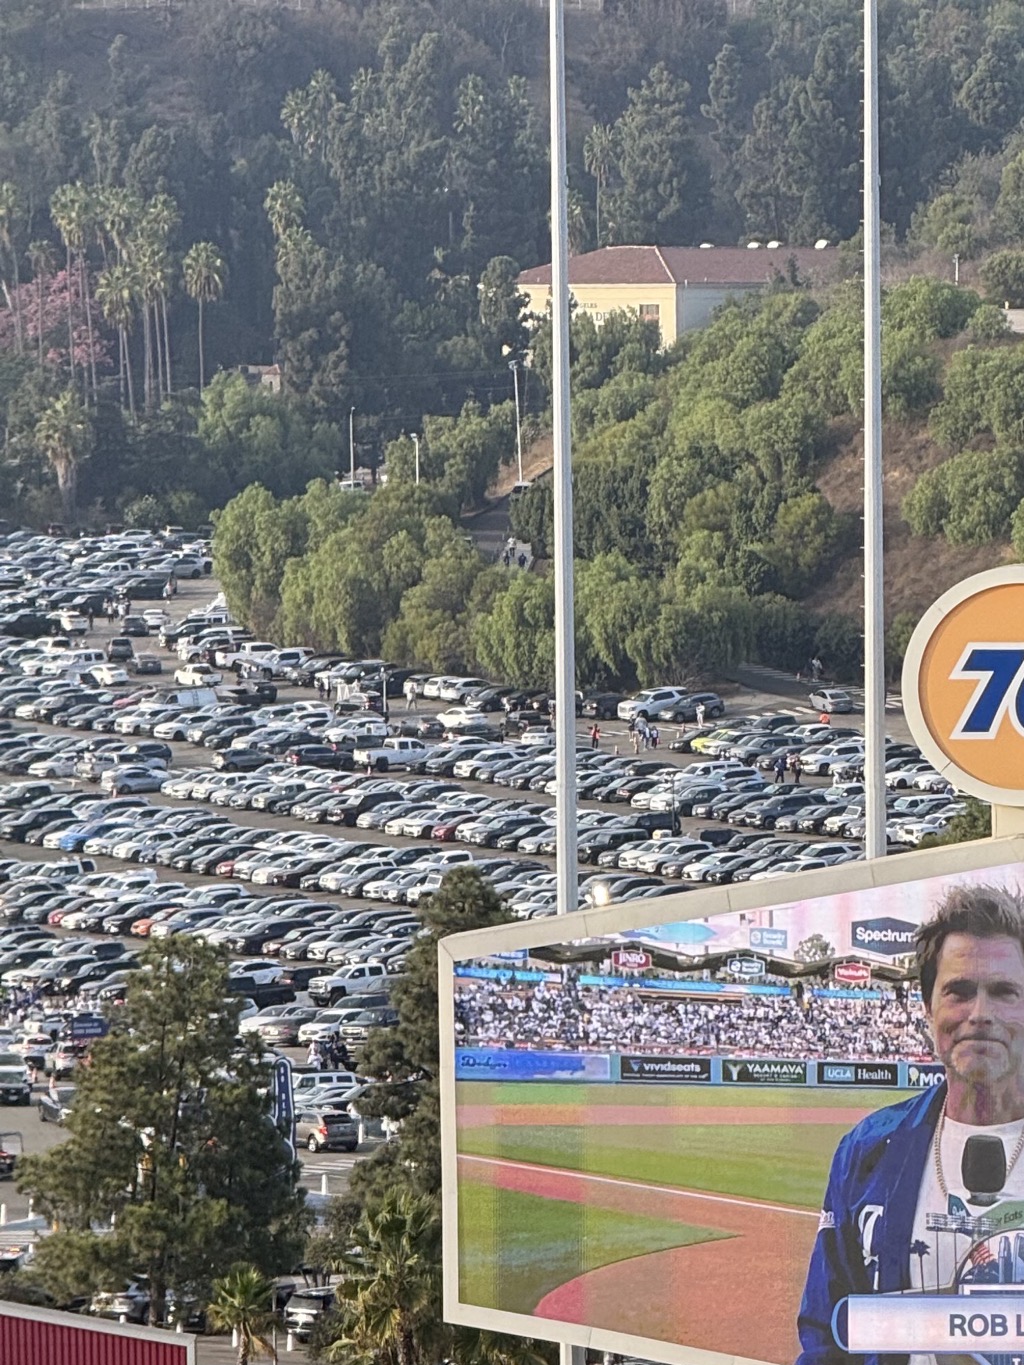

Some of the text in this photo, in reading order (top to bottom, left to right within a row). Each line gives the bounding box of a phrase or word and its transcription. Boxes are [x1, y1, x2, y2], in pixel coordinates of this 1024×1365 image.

[856, 926, 916, 943] Spectrum
[643, 1061, 701, 1072] vividseats
[828, 1067, 892, 1080] UCLA Health
[920, 1072, 946, 1087] MO
[949, 1313, 1008, 1337] ROB
